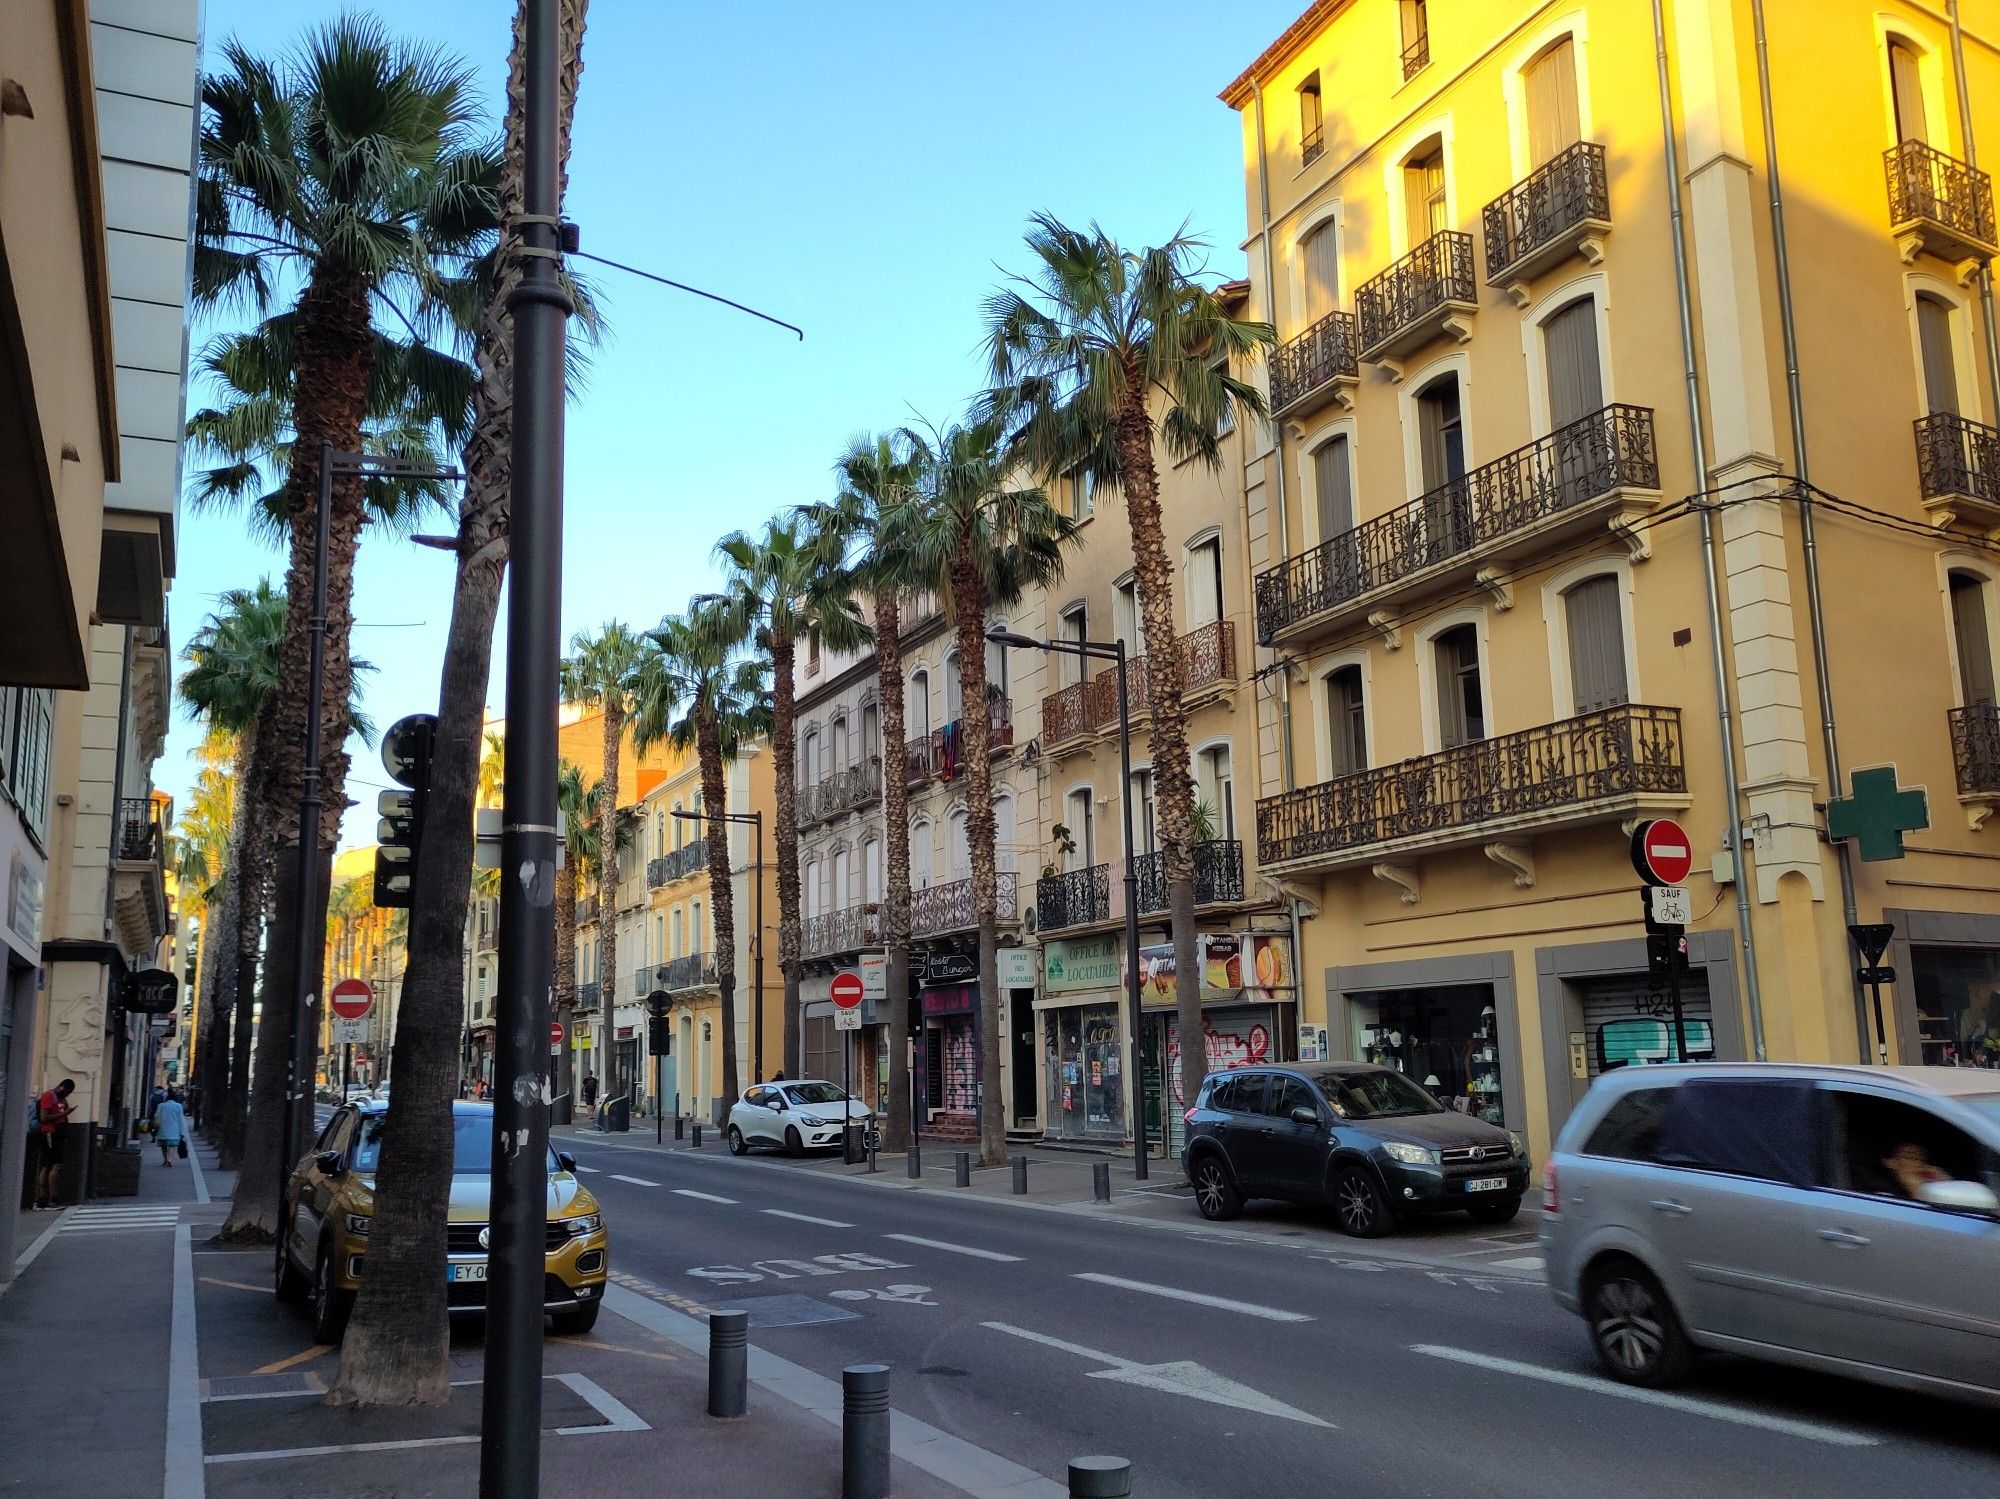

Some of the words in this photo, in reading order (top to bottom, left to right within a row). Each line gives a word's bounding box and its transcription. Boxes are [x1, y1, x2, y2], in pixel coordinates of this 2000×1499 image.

[1660, 889, 1681, 898] SAUF
[1070, 944, 1099, 960] OFFICE
[1005, 975, 1035, 983] LOCATAIRES
[455, 1266, 488, 1279] EY-0
